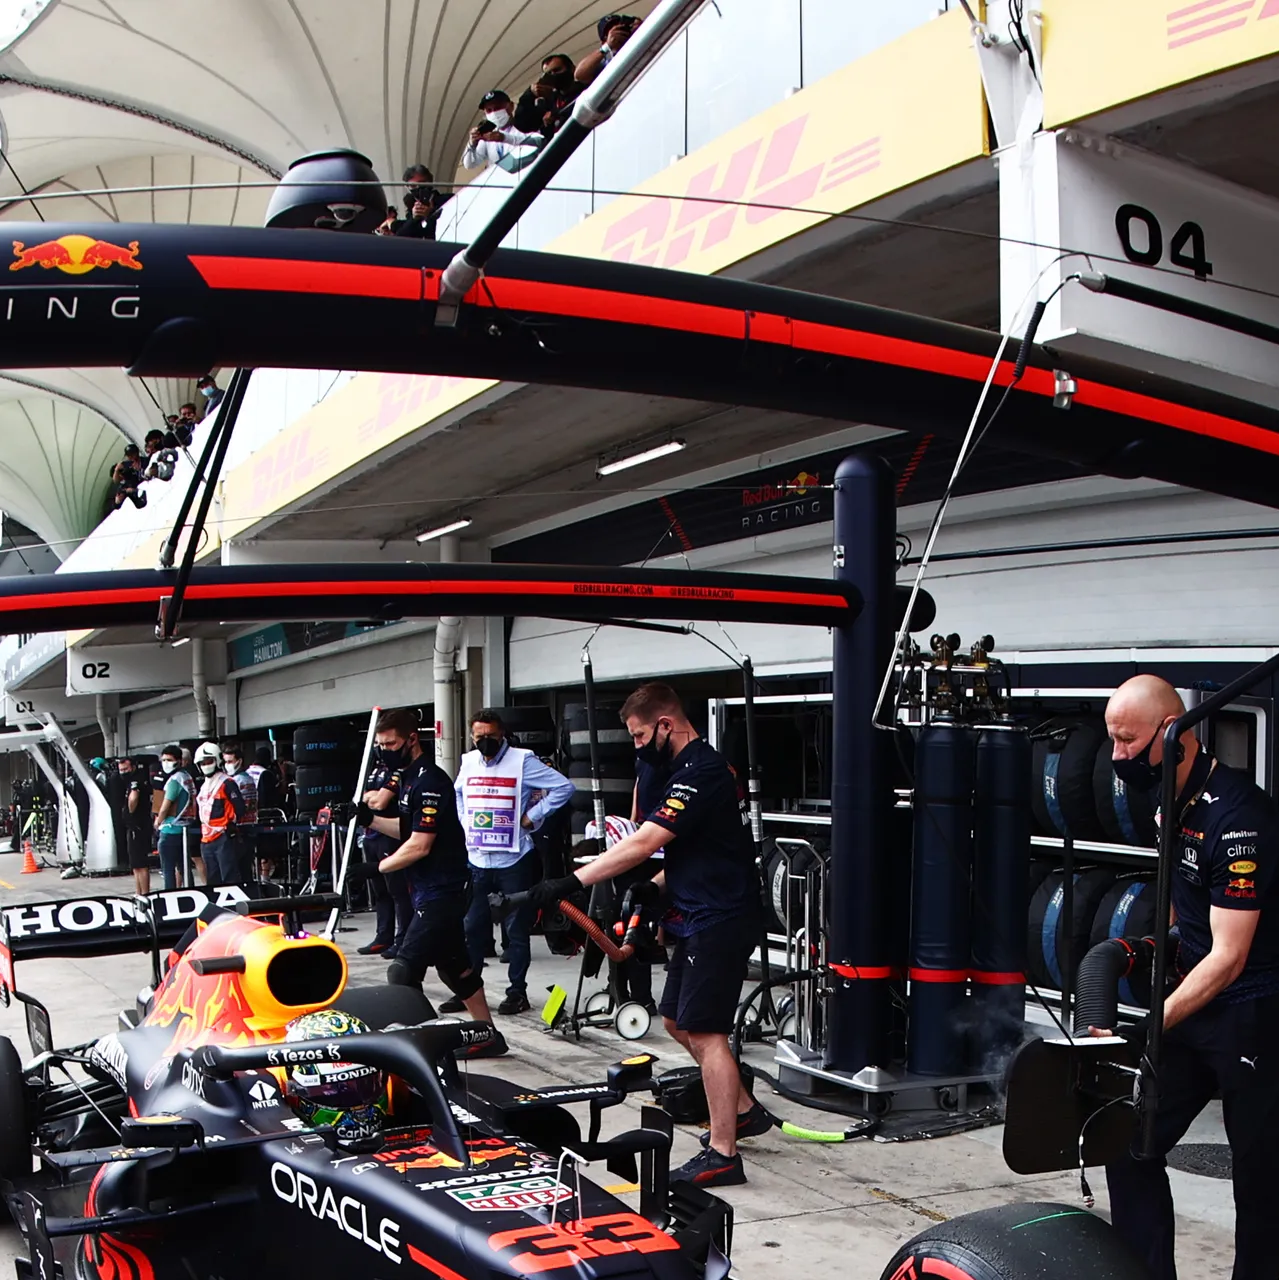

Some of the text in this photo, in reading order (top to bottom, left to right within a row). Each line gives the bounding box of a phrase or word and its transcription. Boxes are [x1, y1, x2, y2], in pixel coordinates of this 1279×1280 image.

[601, 112, 826, 268] DHL
[1115, 203, 1213, 281] 04
[742, 480, 785, 507] Red Bull
[742, 501, 820, 528] RACING
[254, 641, 283, 664] HAMILTON
[81, 662, 110, 679] 02
[17, 700, 35, 713] 01
[1222, 830, 1258, 841] infinitum
[1227, 843, 1257, 858] citrix
[3, 884, 252, 938] HONDA
[281, 1048, 324, 1063] Tezos
[182, 1058, 206, 1098] citrix
[325, 1066, 378, 1083] HONDA
[252, 1099, 279, 1110] INTER
[415, 1166, 557, 1191] HONDA
[452, 1178, 557, 1200] TAG
[466, 1188, 574, 1211] HEUER
[271, 1161, 403, 1264] ORACLE
[487, 1212, 681, 1274] 33
